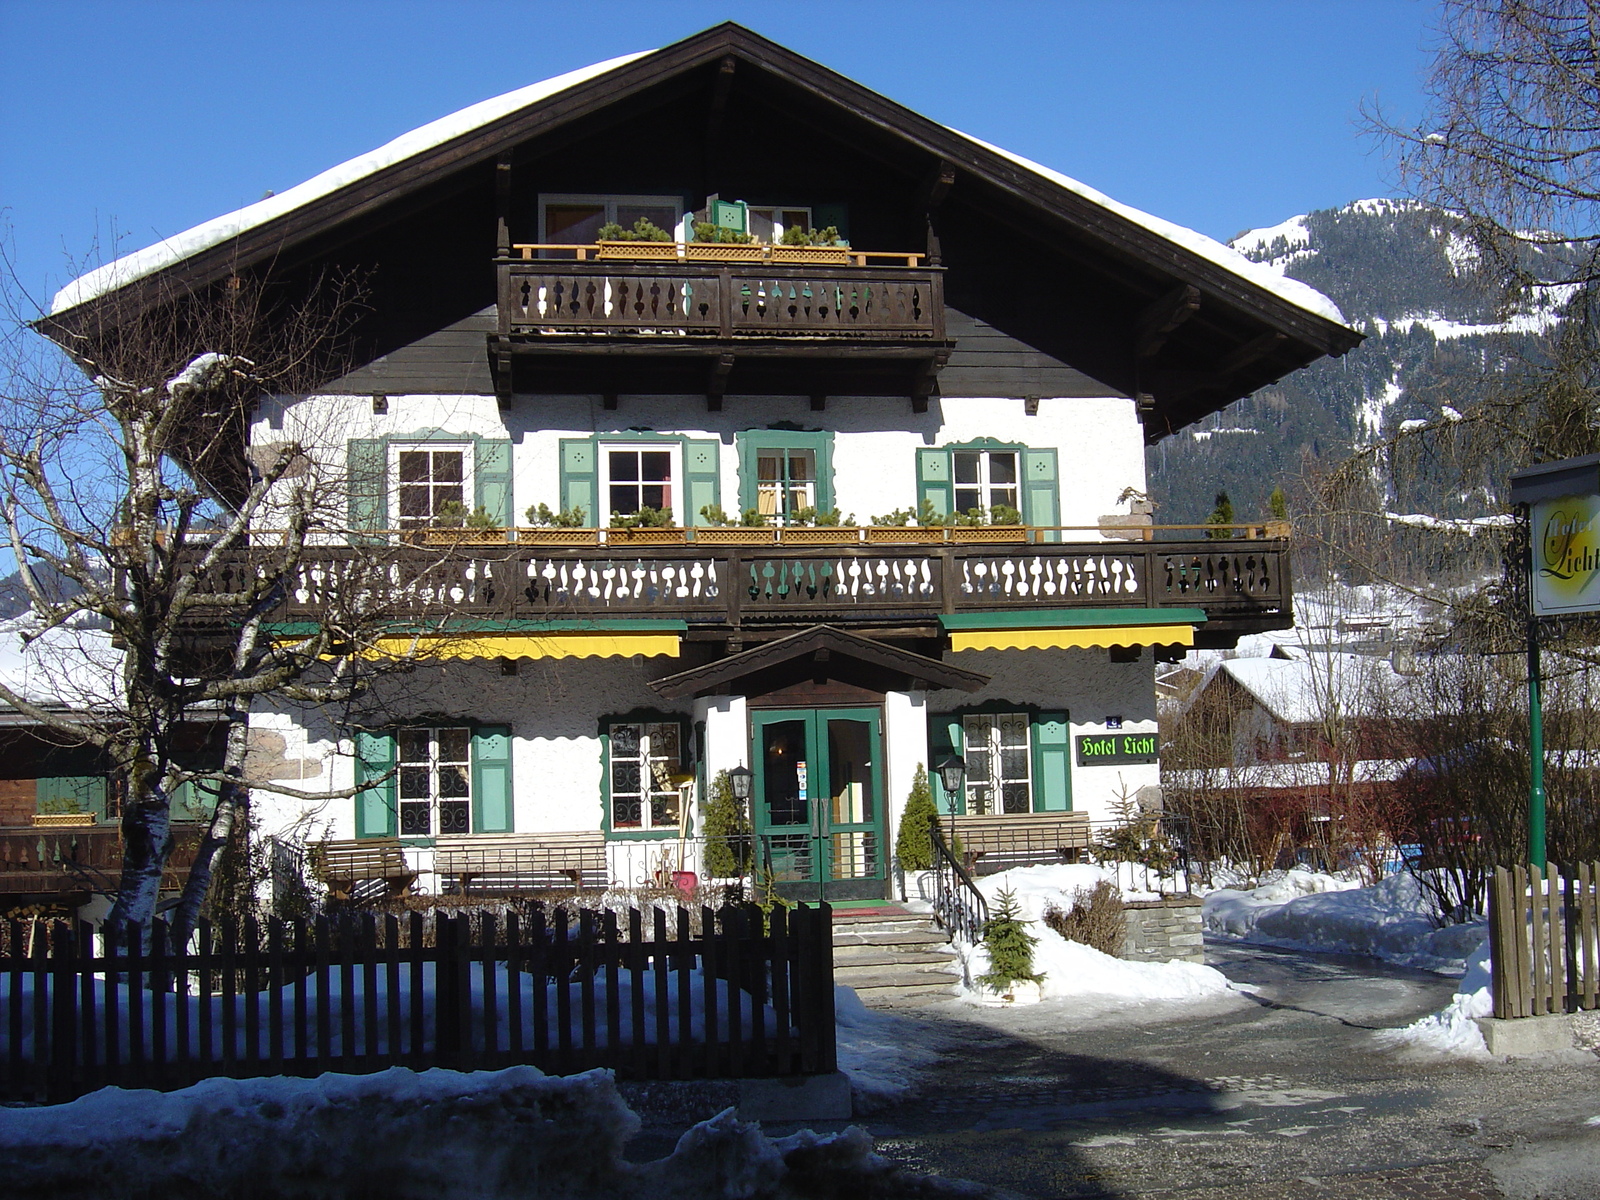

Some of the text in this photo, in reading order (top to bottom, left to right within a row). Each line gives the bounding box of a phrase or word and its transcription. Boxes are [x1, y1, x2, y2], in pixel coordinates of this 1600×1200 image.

[1538, 510, 1600, 580] Licht
[1081, 736, 1155, 756] Hotel Licht
